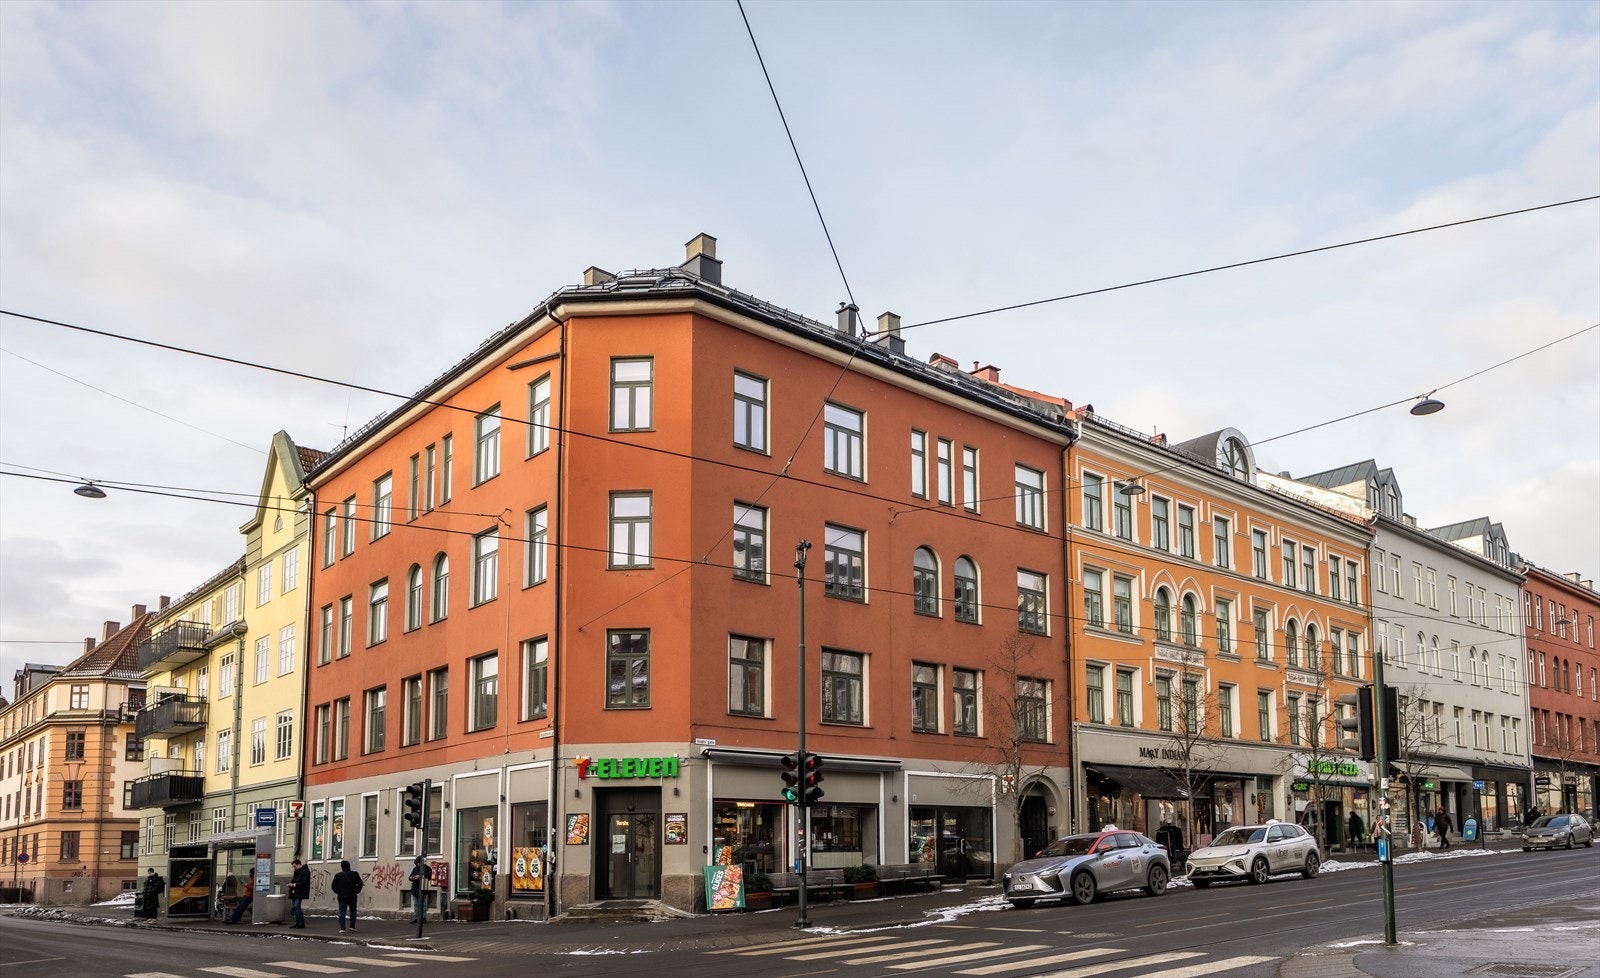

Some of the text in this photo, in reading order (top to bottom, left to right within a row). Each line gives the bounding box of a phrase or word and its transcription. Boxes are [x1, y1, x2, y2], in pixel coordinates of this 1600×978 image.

[1140, 747, 1159, 759] MARY
[1275, 848, 1289, 858] Uber
[516, 863, 524, 873] 35
[531, 863, 539, 873] 35
[712, 870, 724, 890] SLICES
